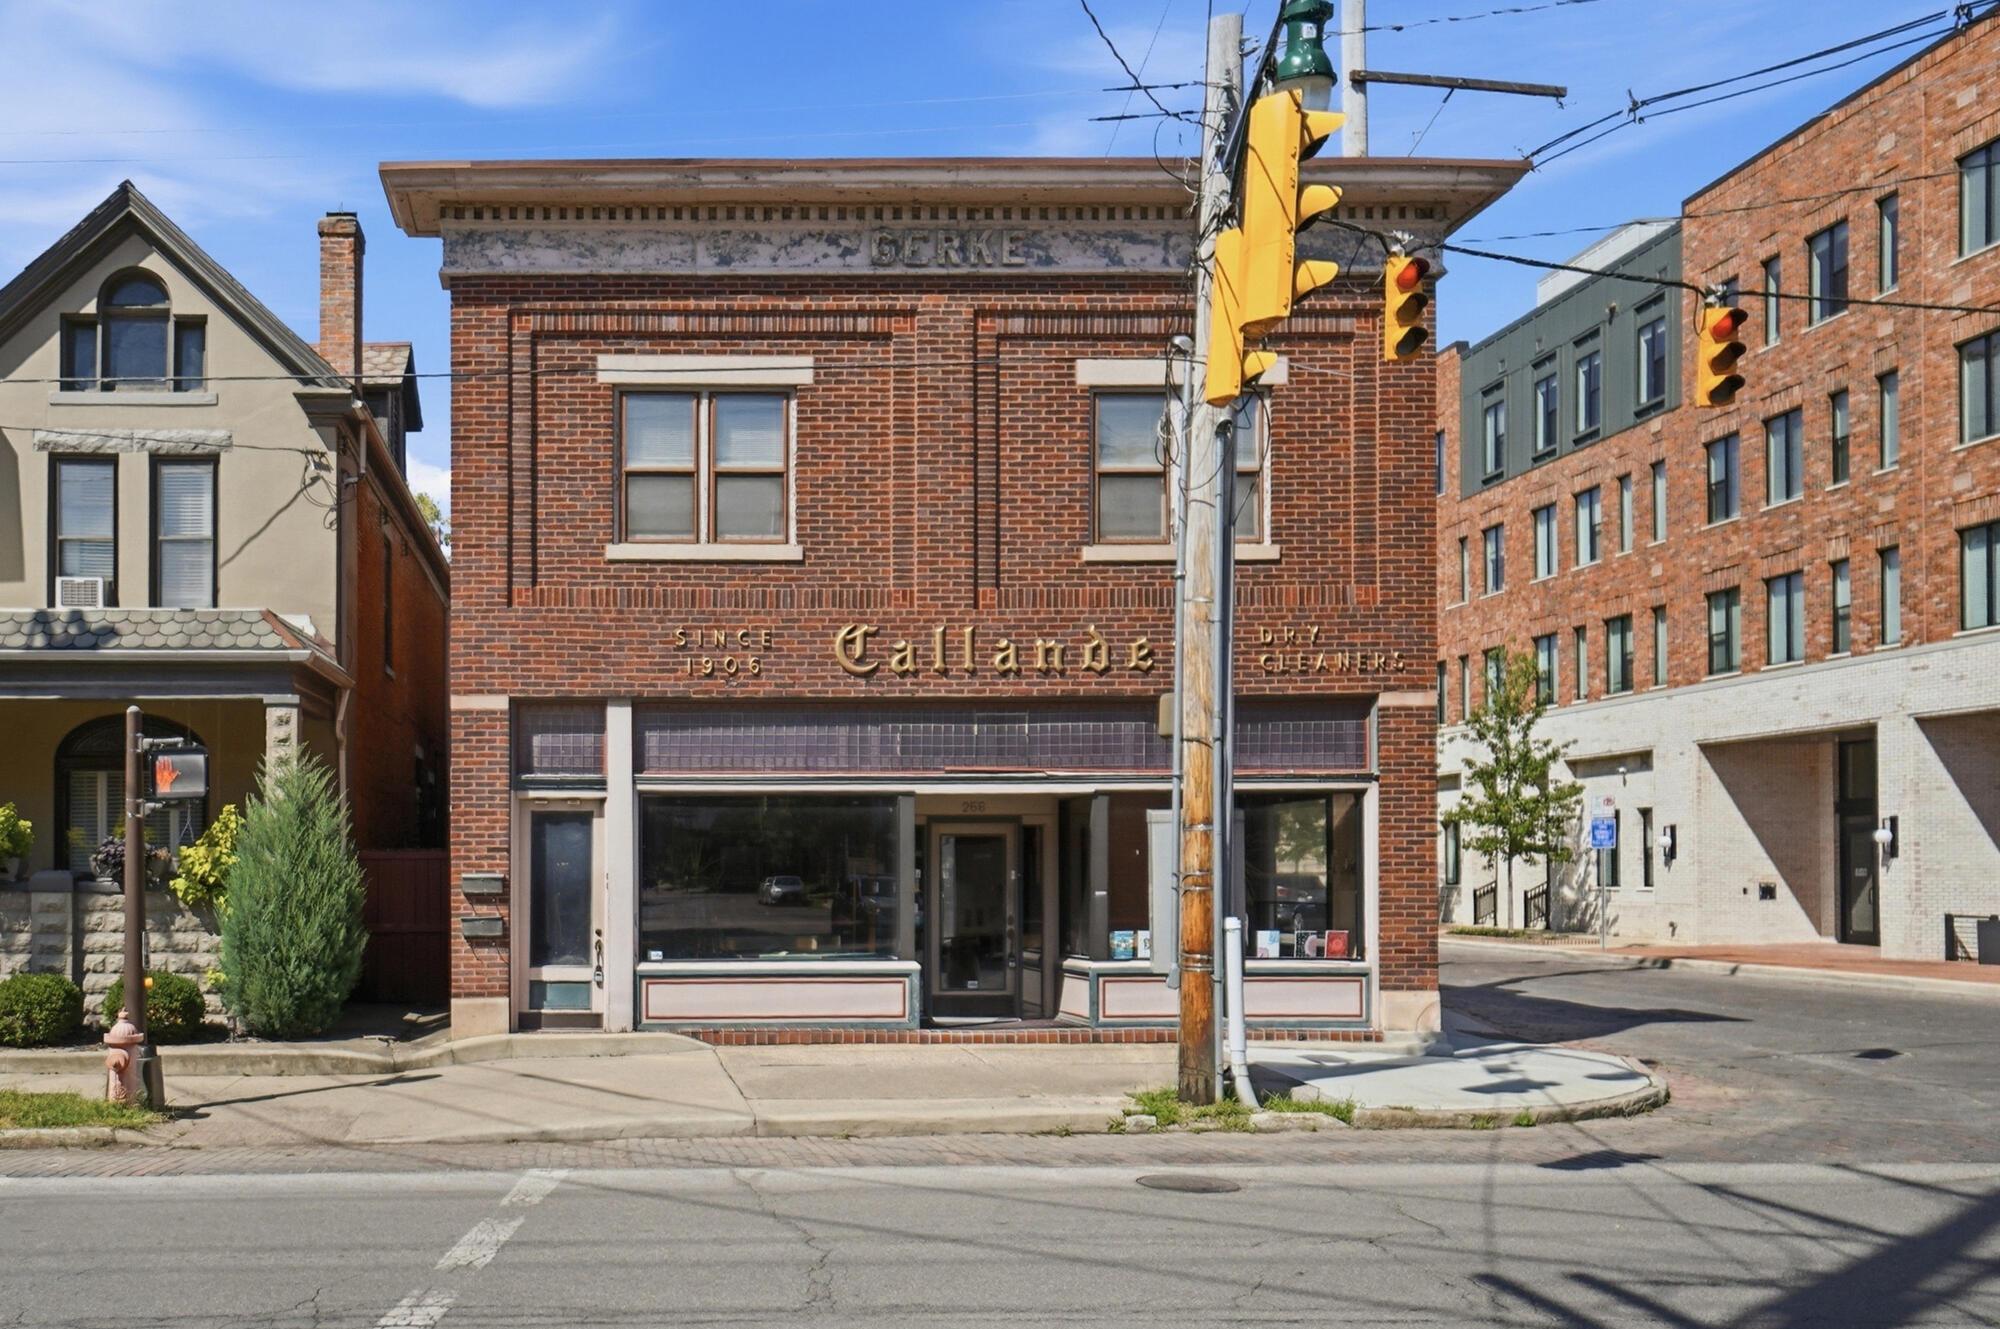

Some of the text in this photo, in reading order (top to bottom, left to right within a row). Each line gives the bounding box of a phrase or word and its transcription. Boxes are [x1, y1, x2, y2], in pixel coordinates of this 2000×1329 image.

[674, 628, 773, 648] SINCE
[1260, 625, 1320, 645] DRY
[835, 624, 1176, 676] Callande
[687, 656, 762, 676] 1906
[1260, 651, 1406, 672] CLEANERS
